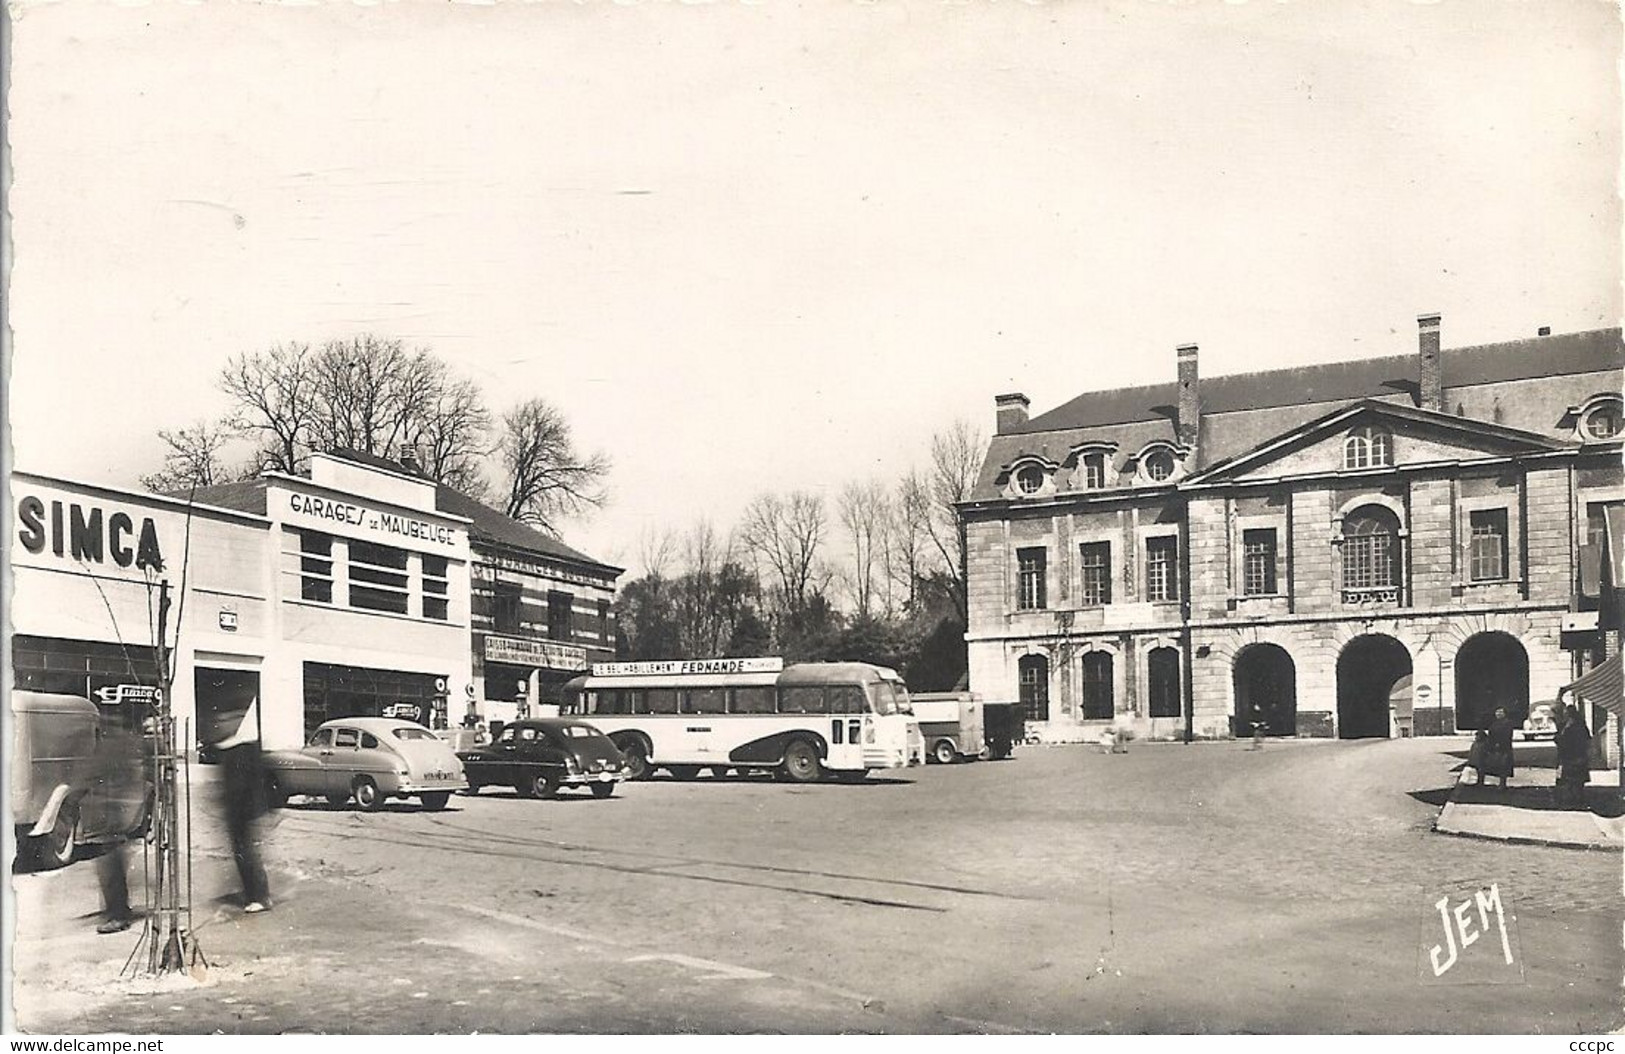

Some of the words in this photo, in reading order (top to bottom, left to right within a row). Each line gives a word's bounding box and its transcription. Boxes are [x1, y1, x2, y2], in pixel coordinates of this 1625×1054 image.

[18, 495, 163, 573] SIMCA
[290, 494, 366, 526] GARAGES
[380, 513, 456, 546] MAUBEUGE
[624, 662, 676, 674] HABILLEMENT
[681, 660, 745, 675] FERNANDE
